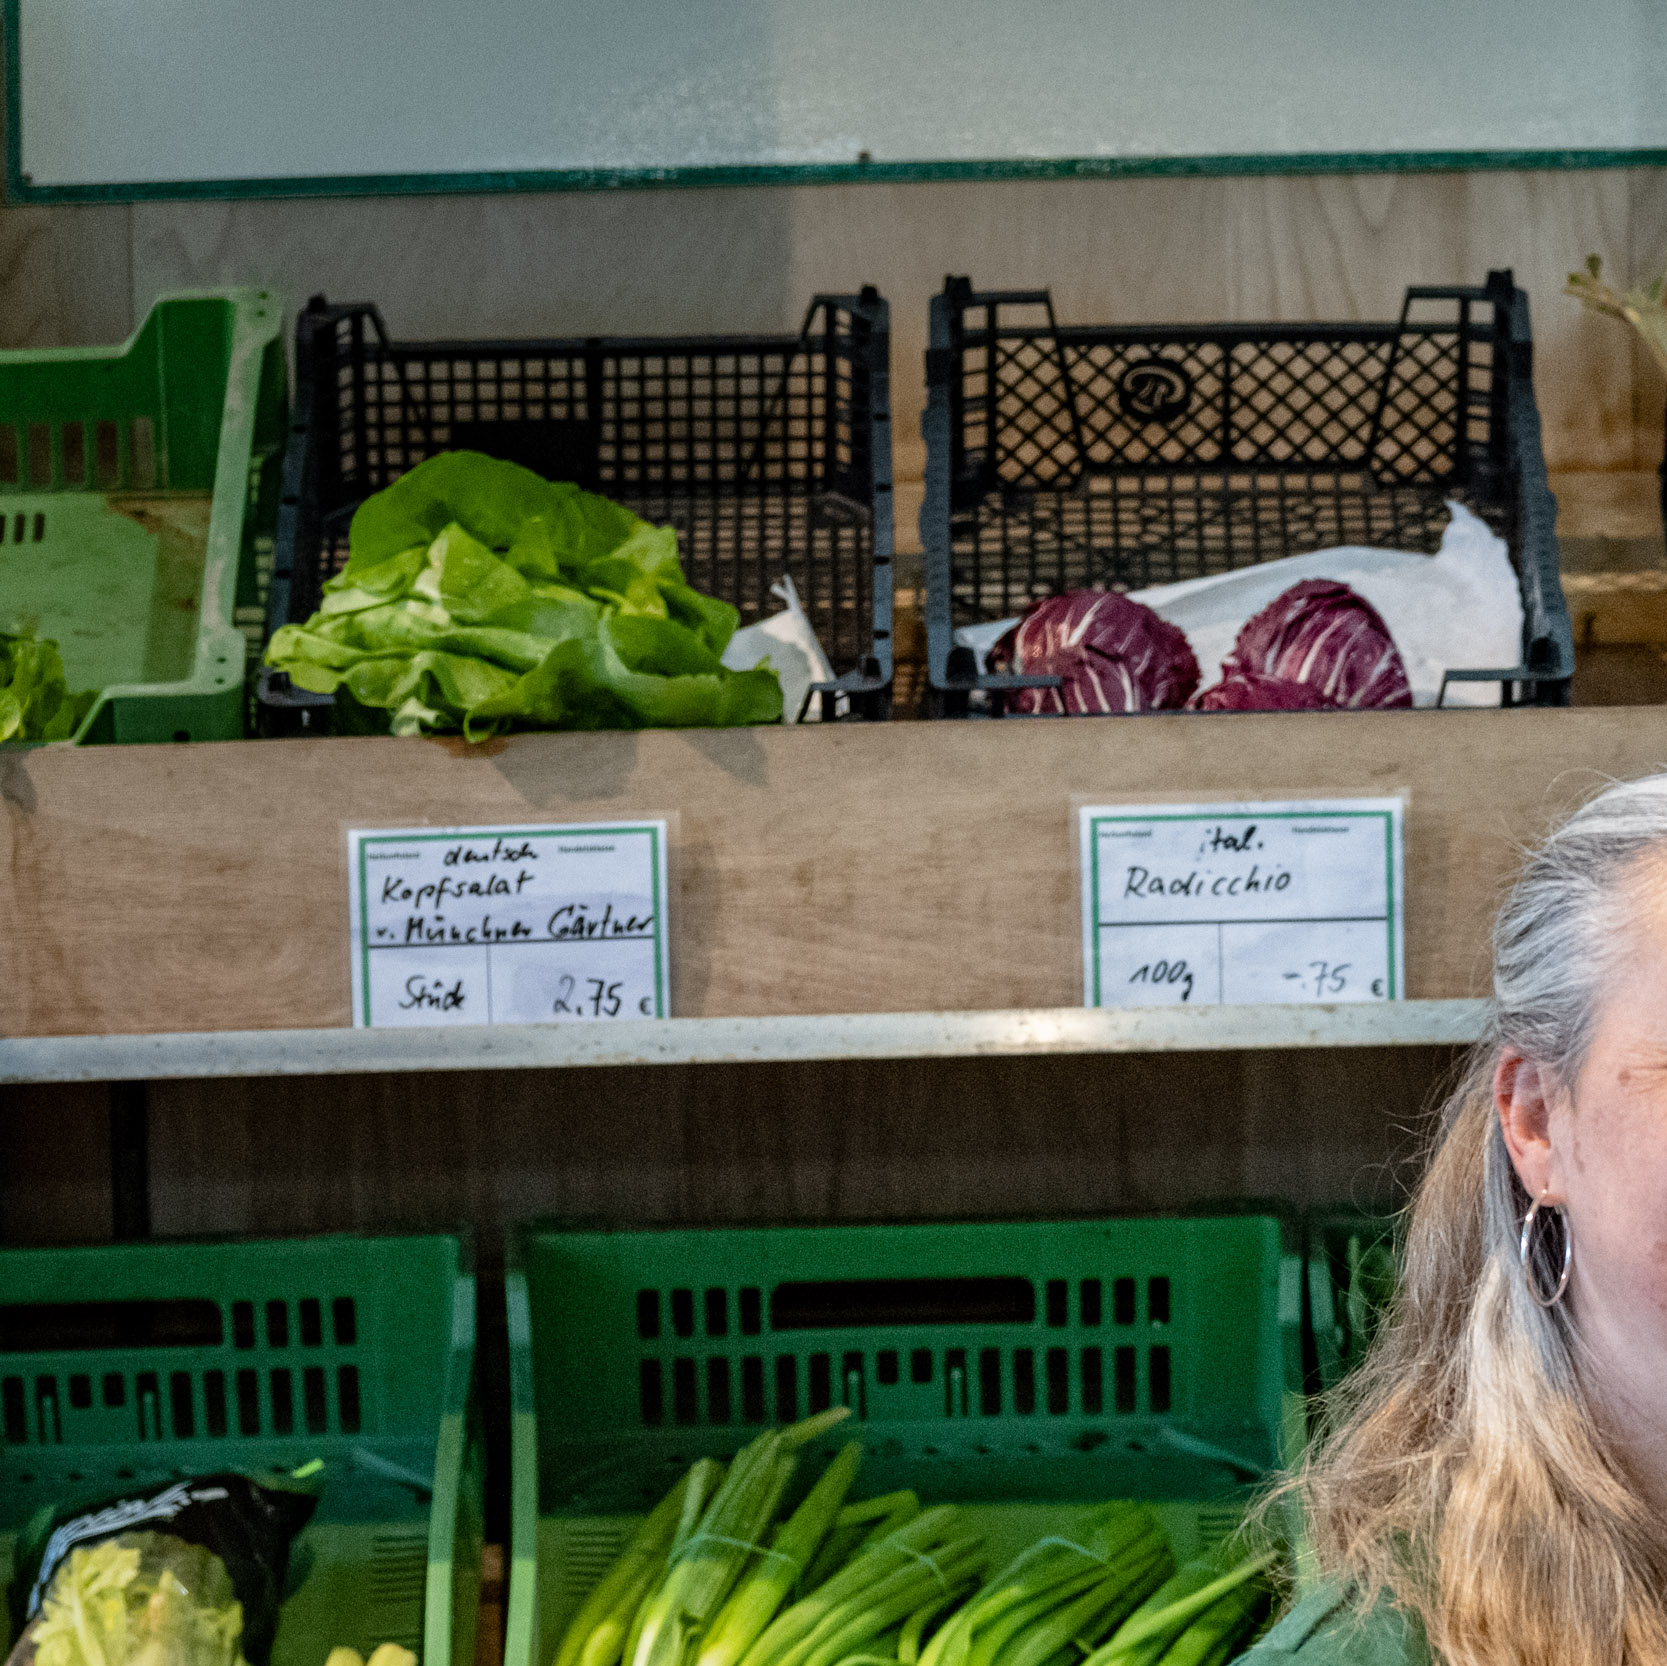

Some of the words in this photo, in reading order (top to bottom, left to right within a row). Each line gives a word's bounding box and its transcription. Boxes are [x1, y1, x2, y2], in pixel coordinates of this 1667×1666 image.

[1200, 825, 1264, 851] ital.
[381, 870, 534, 909] Kopfsalat
[1123, 864, 1292, 899] Radicchio
[546, 905, 654, 941] Gärtner
[554, 974, 623, 1018] 2.75
[639, 997, 651, 1016] €
[1129, 960, 1195, 1002] 100g
[1371, 980, 1384, 997] €
